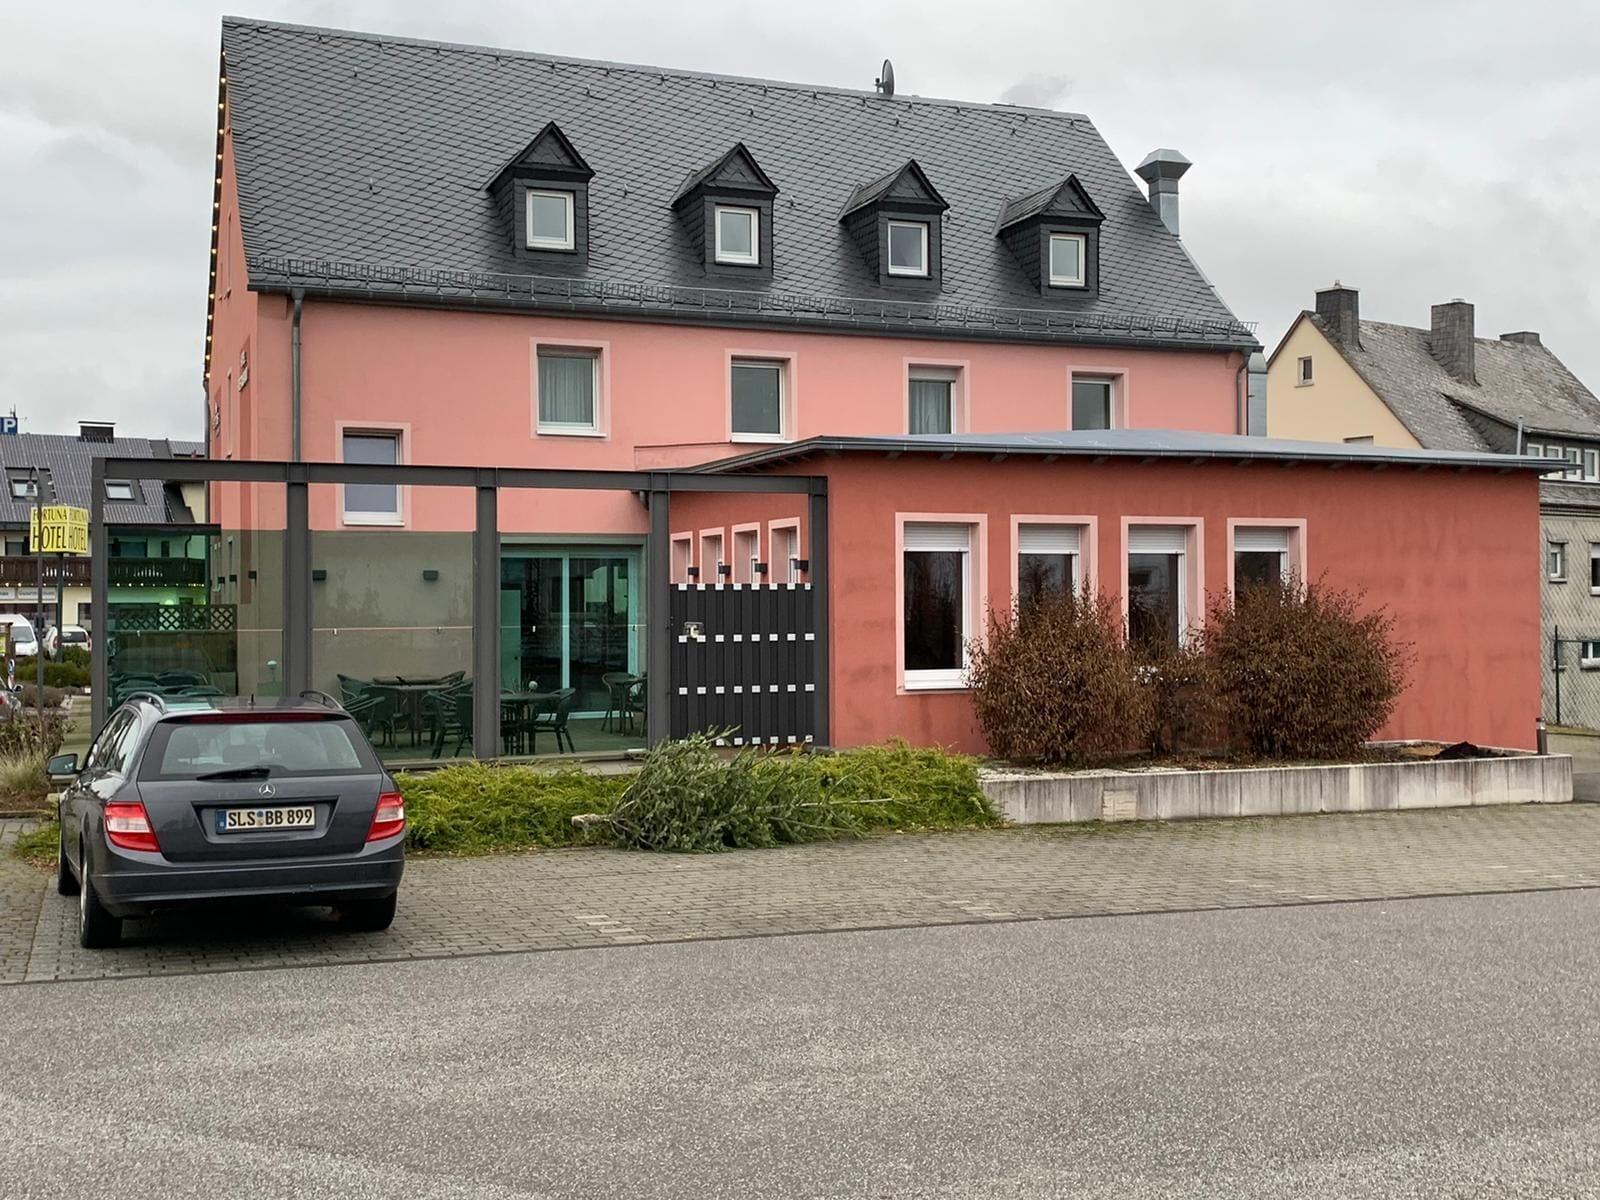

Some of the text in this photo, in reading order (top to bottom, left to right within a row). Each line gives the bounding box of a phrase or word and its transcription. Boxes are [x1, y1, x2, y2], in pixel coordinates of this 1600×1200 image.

[4, 418, 16, 433] P
[32, 508, 67, 521] FRTUNA
[32, 526, 67, 549] HOTEL
[69, 526, 87, 551] HOTEL
[228, 808, 313, 827] SLS BB 899
